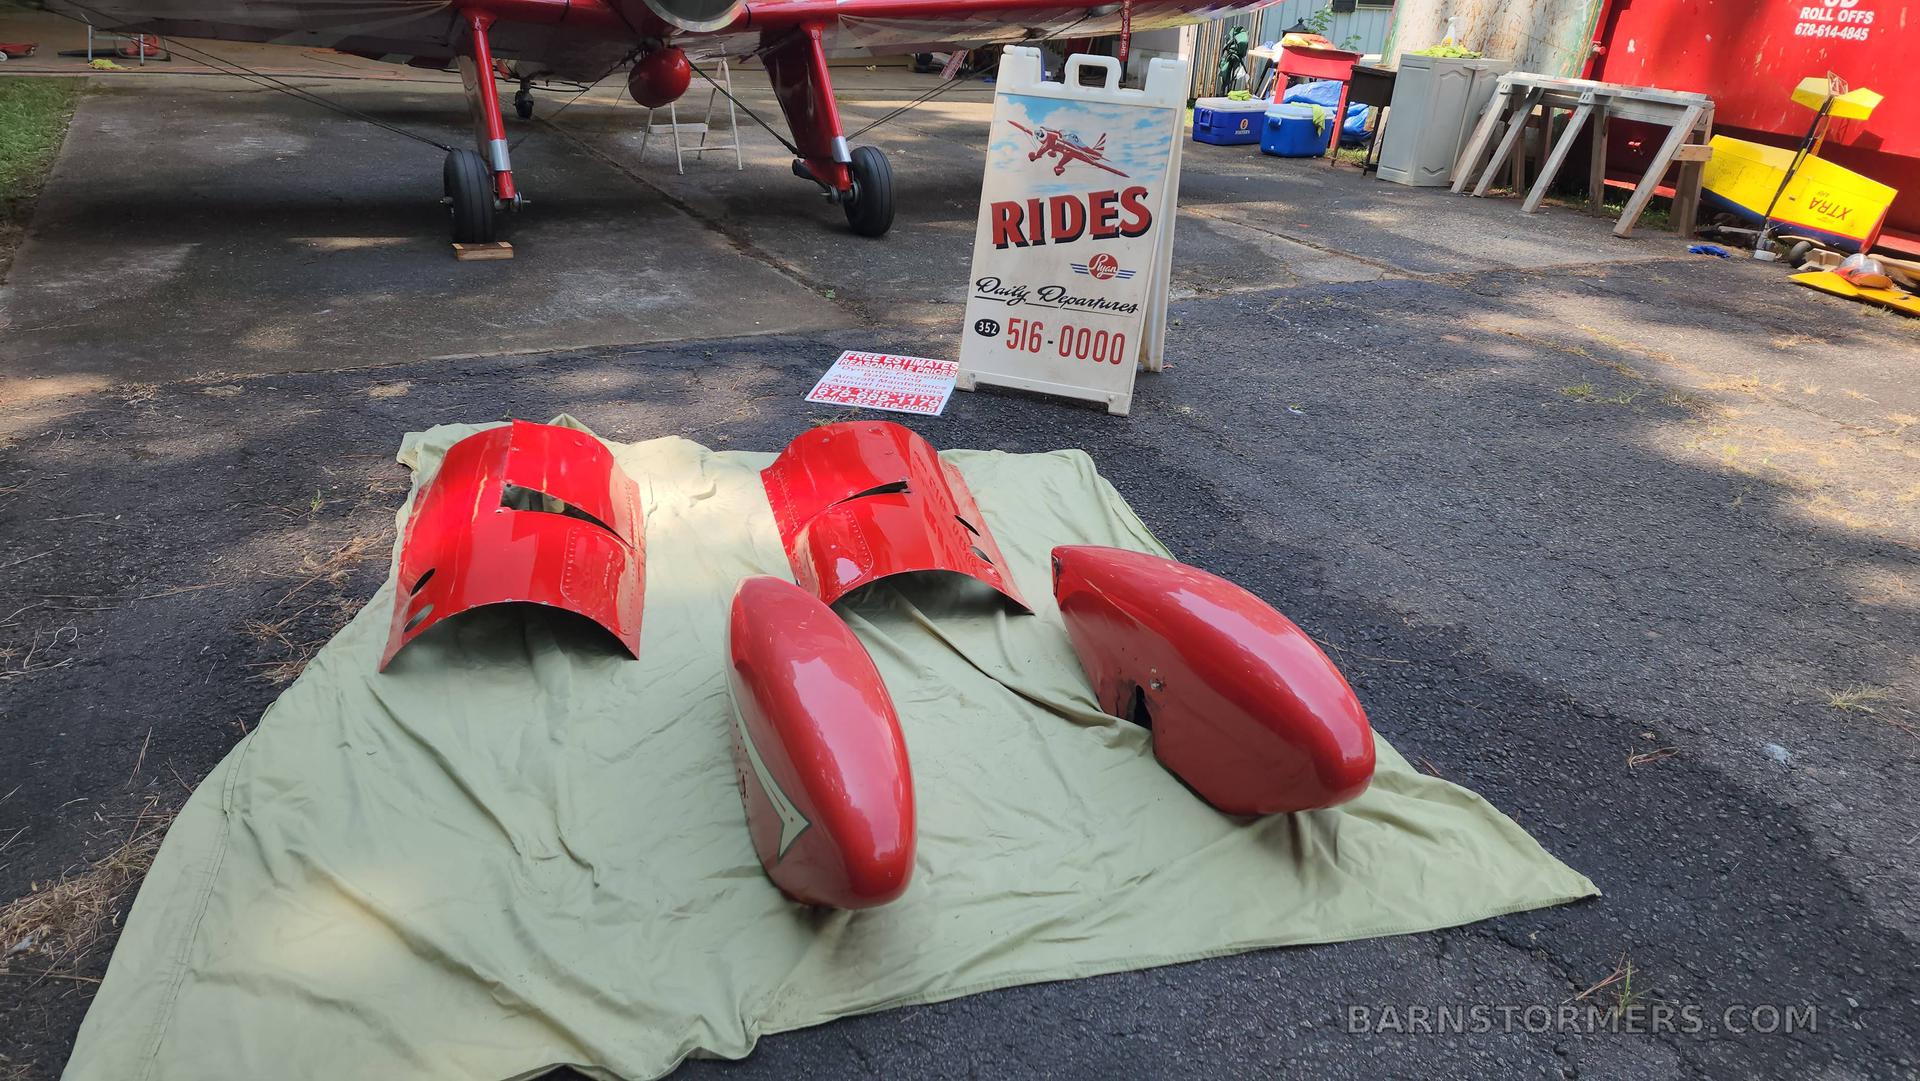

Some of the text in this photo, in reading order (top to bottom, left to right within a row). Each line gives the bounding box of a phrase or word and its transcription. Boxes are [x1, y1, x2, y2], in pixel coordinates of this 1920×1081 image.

[1800, 7, 1874, 24] ROLL OFFS
[1795, 22, 1869, 41] 678-614-4845
[991, 186, 1152, 249] RIDES
[1809, 197, 1853, 220] XTRA
[1089, 254, 1117, 278] Ryan
[975, 276, 1138, 314] Daily Departures
[978, 321, 997, 335] 352
[841, 359, 915, 372] REASONABLE
[845, 352, 959, 370] FREE ESTIMATES
